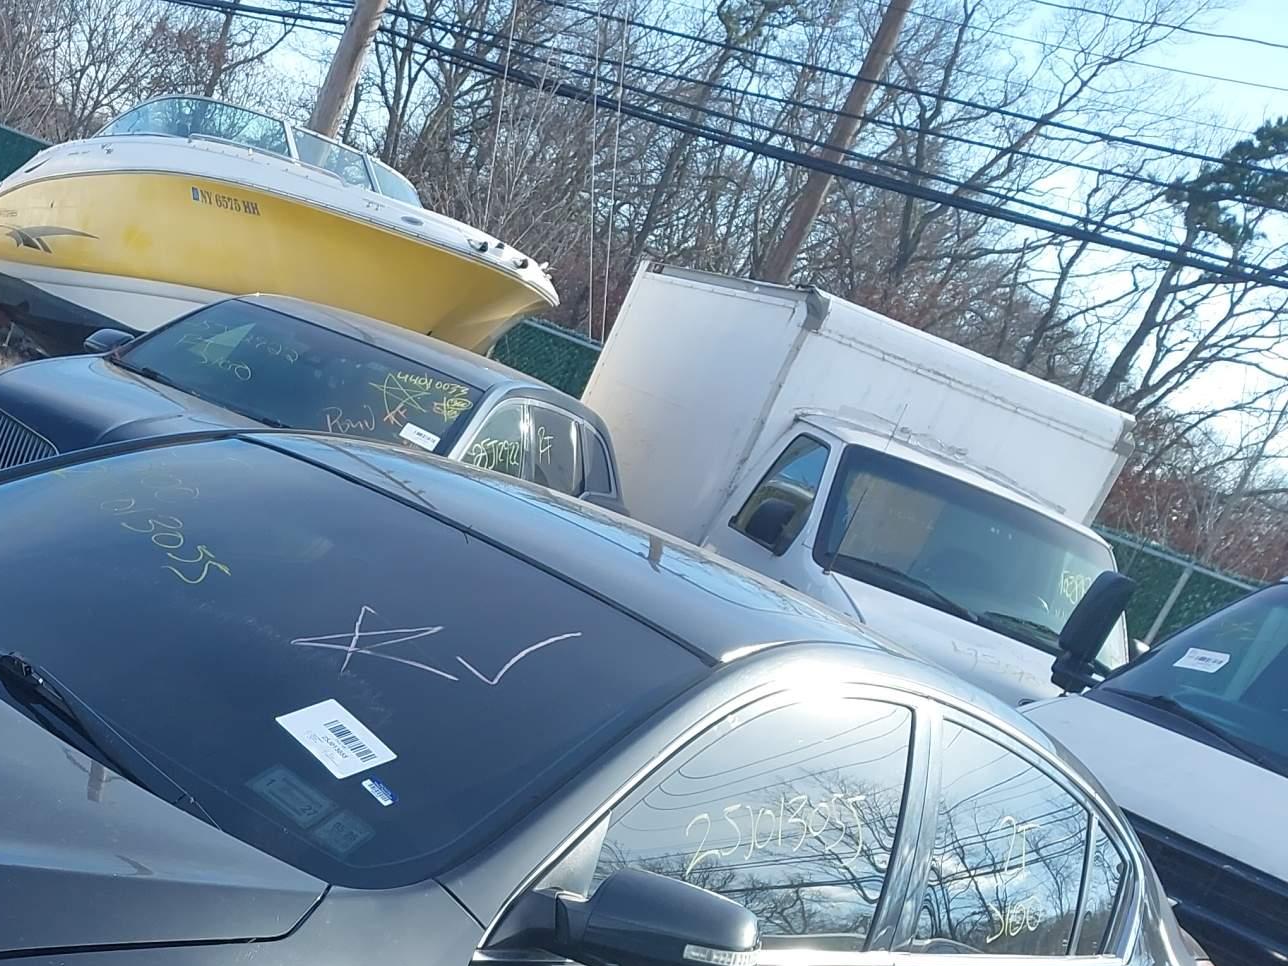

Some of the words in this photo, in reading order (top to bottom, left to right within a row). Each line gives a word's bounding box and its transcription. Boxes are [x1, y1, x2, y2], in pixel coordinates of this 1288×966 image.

[200, 189, 212, 205] NY
[215, 194, 241, 212] 6575
[243, 200, 261, 216] HH
